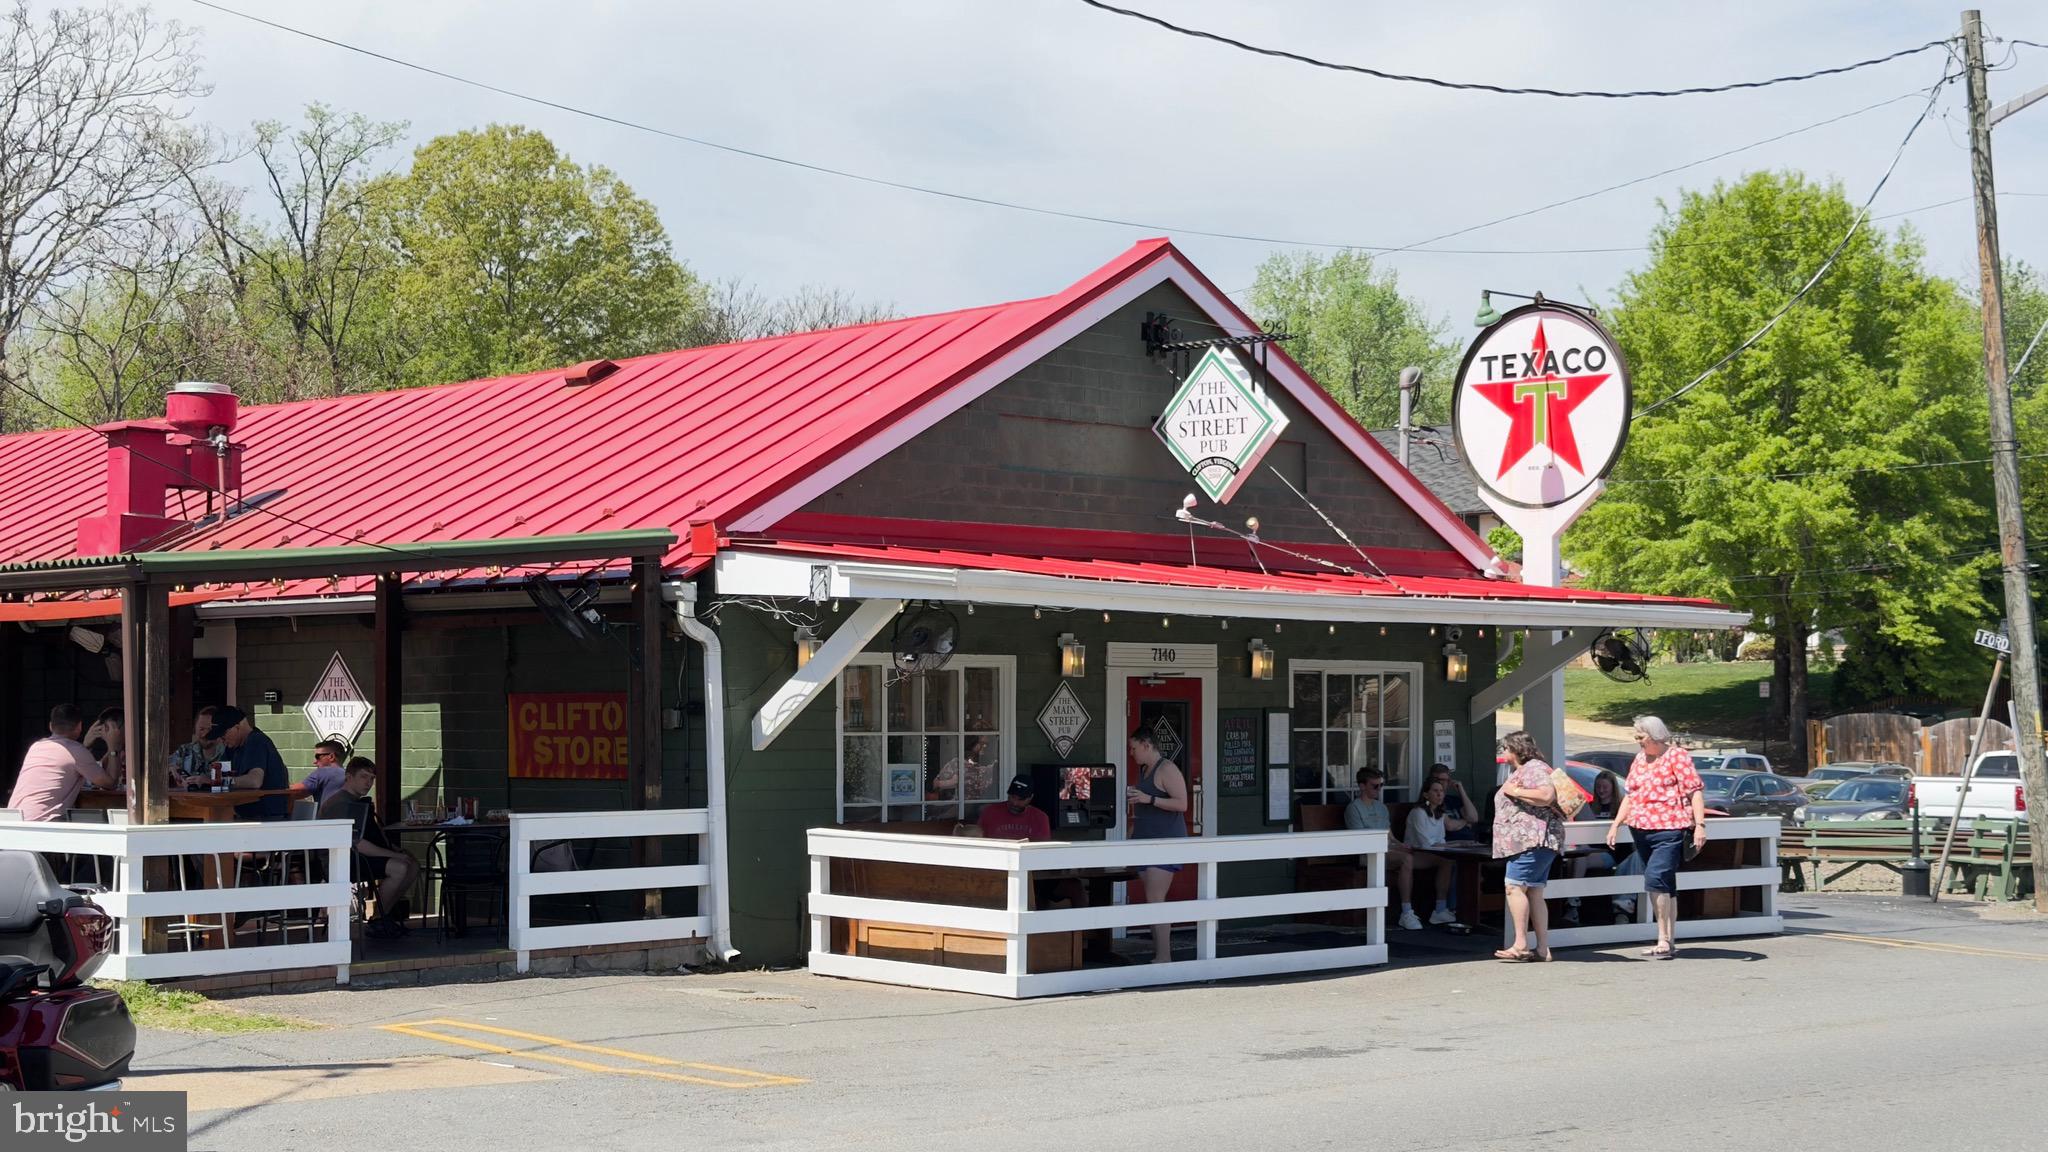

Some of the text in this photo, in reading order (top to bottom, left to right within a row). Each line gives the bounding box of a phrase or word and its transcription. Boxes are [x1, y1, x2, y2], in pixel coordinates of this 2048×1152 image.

[1480, 345, 1606, 381] TEXACO
[1199, 381, 1227, 396] THE
[1187, 396, 1239, 416] MAIN
[1179, 417, 1249, 439] STREET
[1200, 439, 1228, 453] PUB
[1980, 631, 2009, 650] FORD
[1151, 647, 1176, 663] 7140
[329, 676, 345, 687] THE
[322, 688, 351, 702] MAIN
[1058, 697, 1071, 705] THE
[317, 704, 355, 718] STREET
[520, 701, 627, 731] CLIFTO
[1052, 705, 1076, 714] MAIN
[328, 720, 345, 731] PUB
[1048, 716, 1080, 726] STREET
[533, 735, 628, 766] STORE
